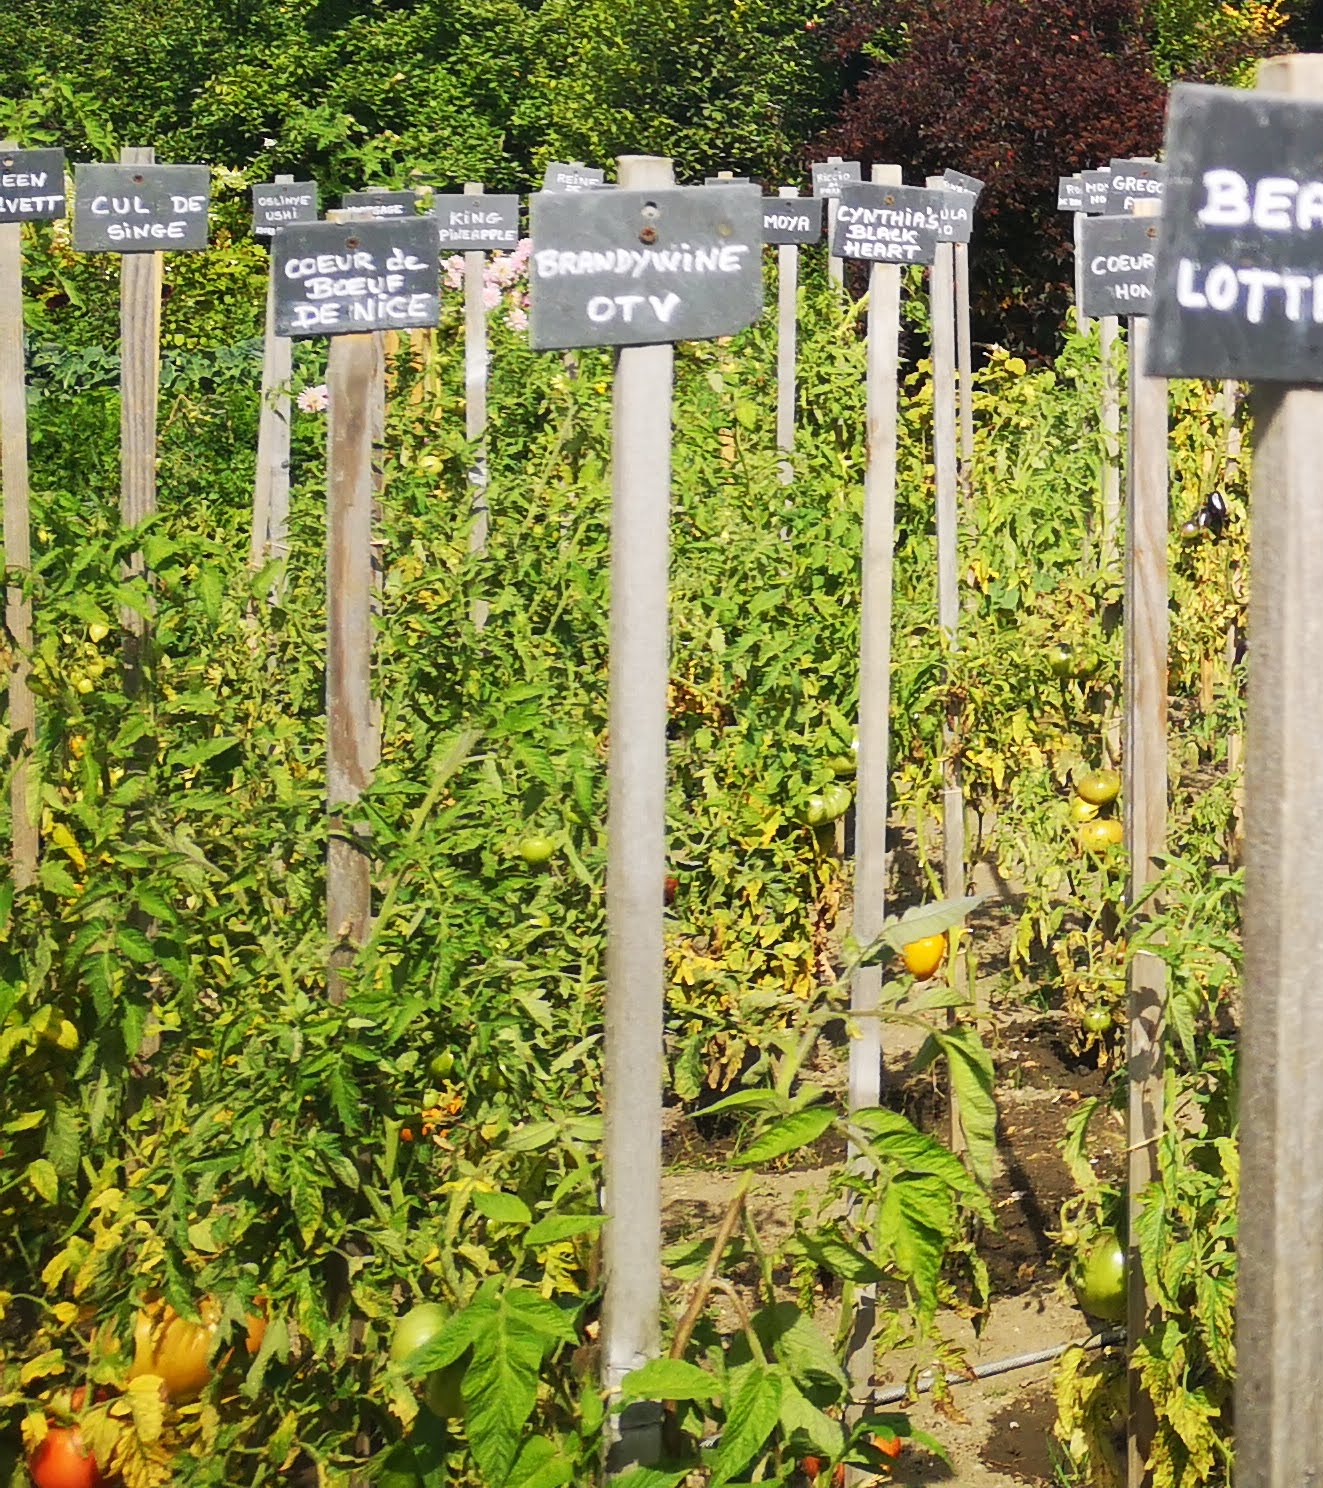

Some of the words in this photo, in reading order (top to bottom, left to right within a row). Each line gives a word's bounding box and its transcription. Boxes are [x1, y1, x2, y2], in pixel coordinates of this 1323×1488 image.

[0, 171, 47, 188] EEN
[91, 196, 150, 214] CUL
[170, 196, 205, 214] DE
[764, 215, 810, 232] MOYA
[935, 208, 968, 221] ULA
[846, 224, 920, 244] BLACK
[843, 240, 922, 260] HEART
[291, 303, 341, 328] DE
